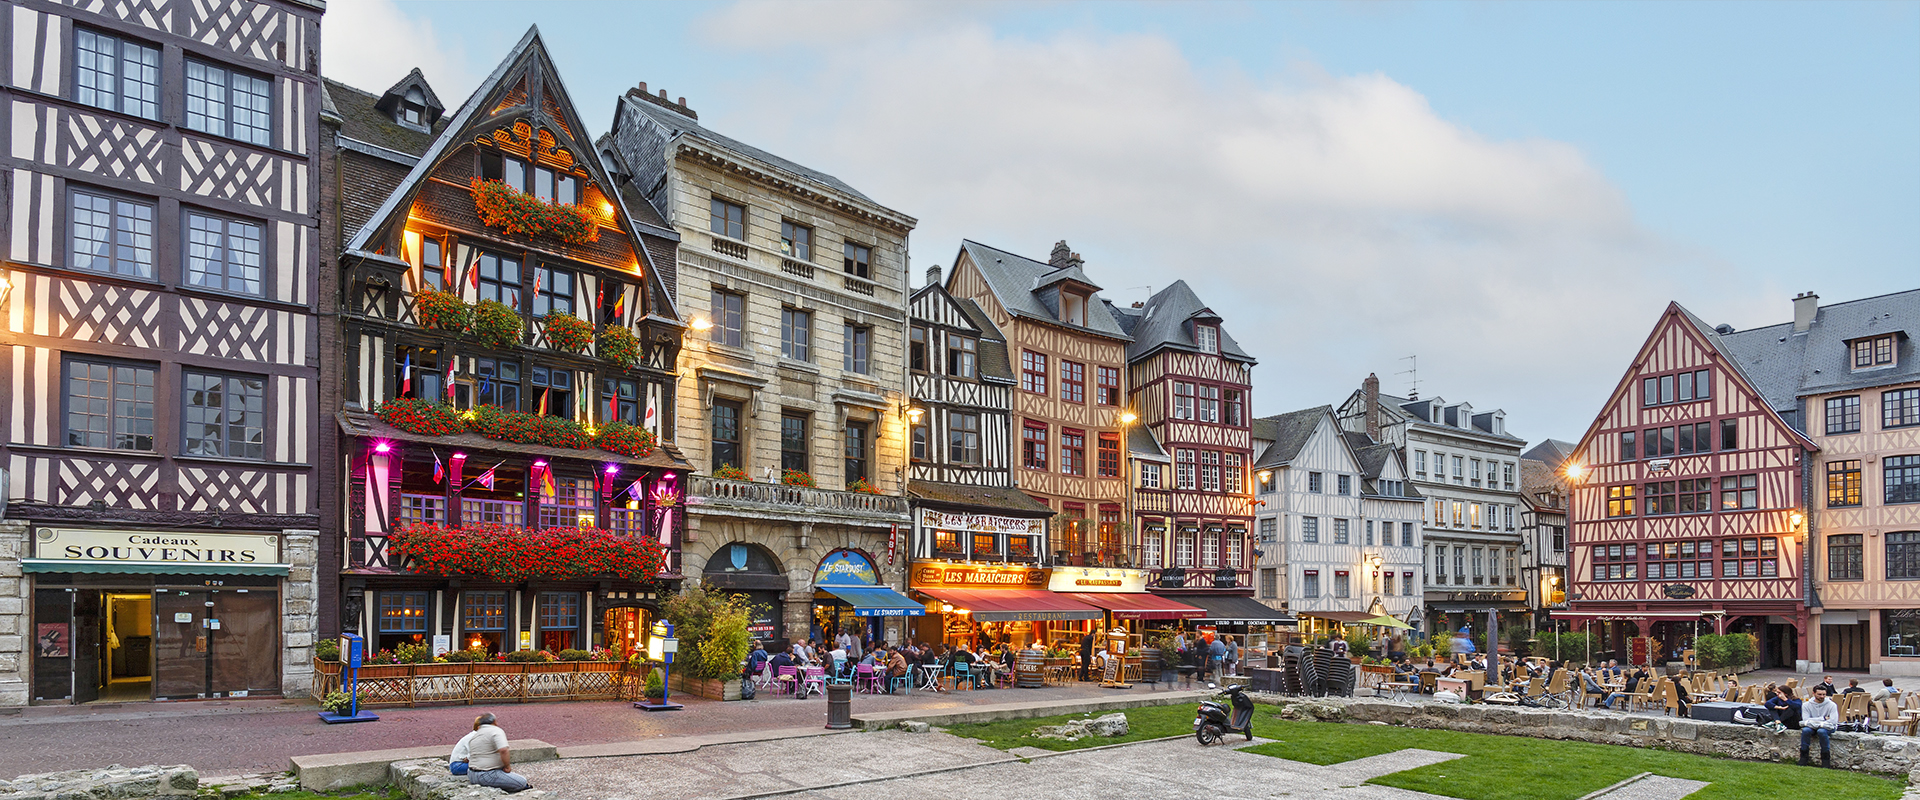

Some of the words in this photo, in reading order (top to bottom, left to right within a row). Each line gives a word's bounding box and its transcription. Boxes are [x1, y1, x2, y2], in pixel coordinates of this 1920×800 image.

[923, 517, 943, 528] 2012
[945, 514, 963, 526] LES
[128, 534, 198, 546] Cadeaux
[888, 525, 896, 564] TABAC
[64, 545, 256, 562] SOUVENIRS
[824, 562, 833, 572] LE
[834, 563, 864, 574] STARDUST
[945, 572, 962, 582] LES
